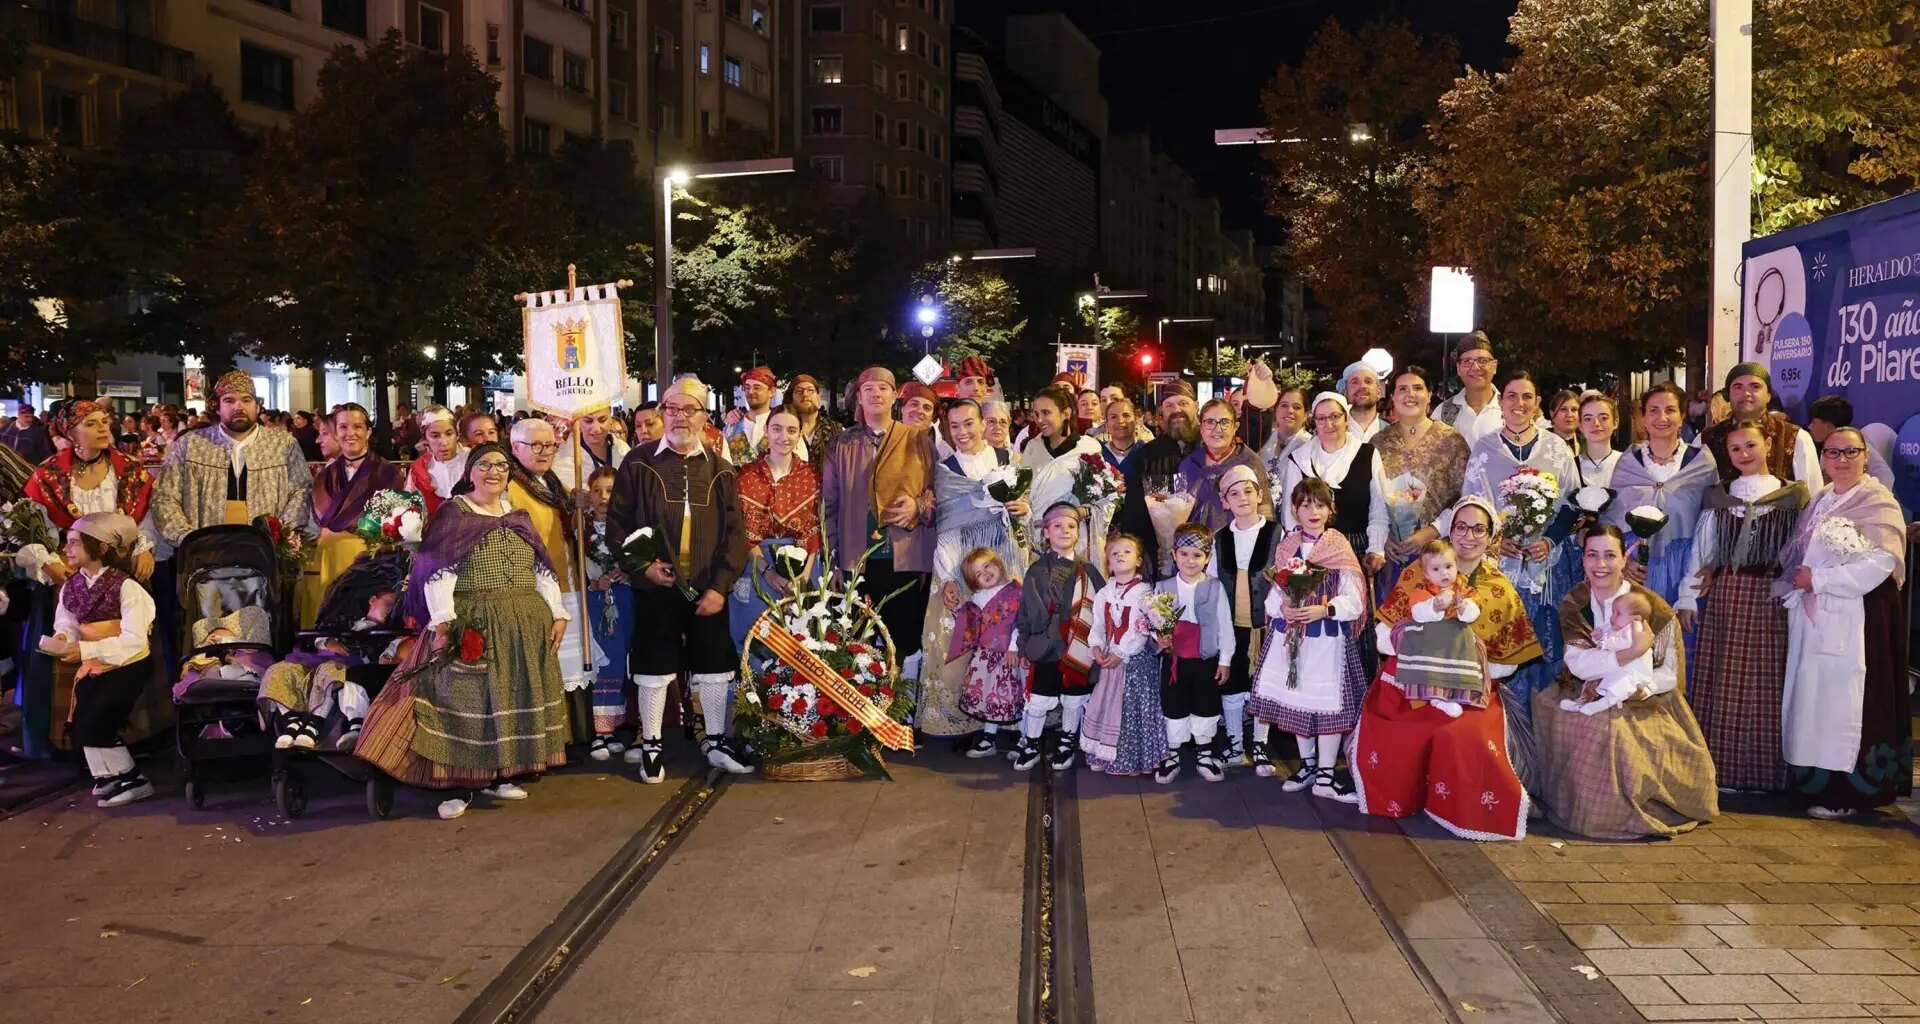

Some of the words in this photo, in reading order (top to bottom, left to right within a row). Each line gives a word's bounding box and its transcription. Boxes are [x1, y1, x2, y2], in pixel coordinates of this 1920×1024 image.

[1849, 255, 1911, 288] HERALDO
[1838, 301, 1878, 344] 130
[1772, 346, 1812, 360] ANIVERSARIO
[1773, 337, 1800, 350] PULSERA
[555, 376, 594, 389] BELLO
[1827, 345, 1852, 388] de
[794, 649, 825, 678] BELLO
[831, 678, 867, 712] TERUEL
